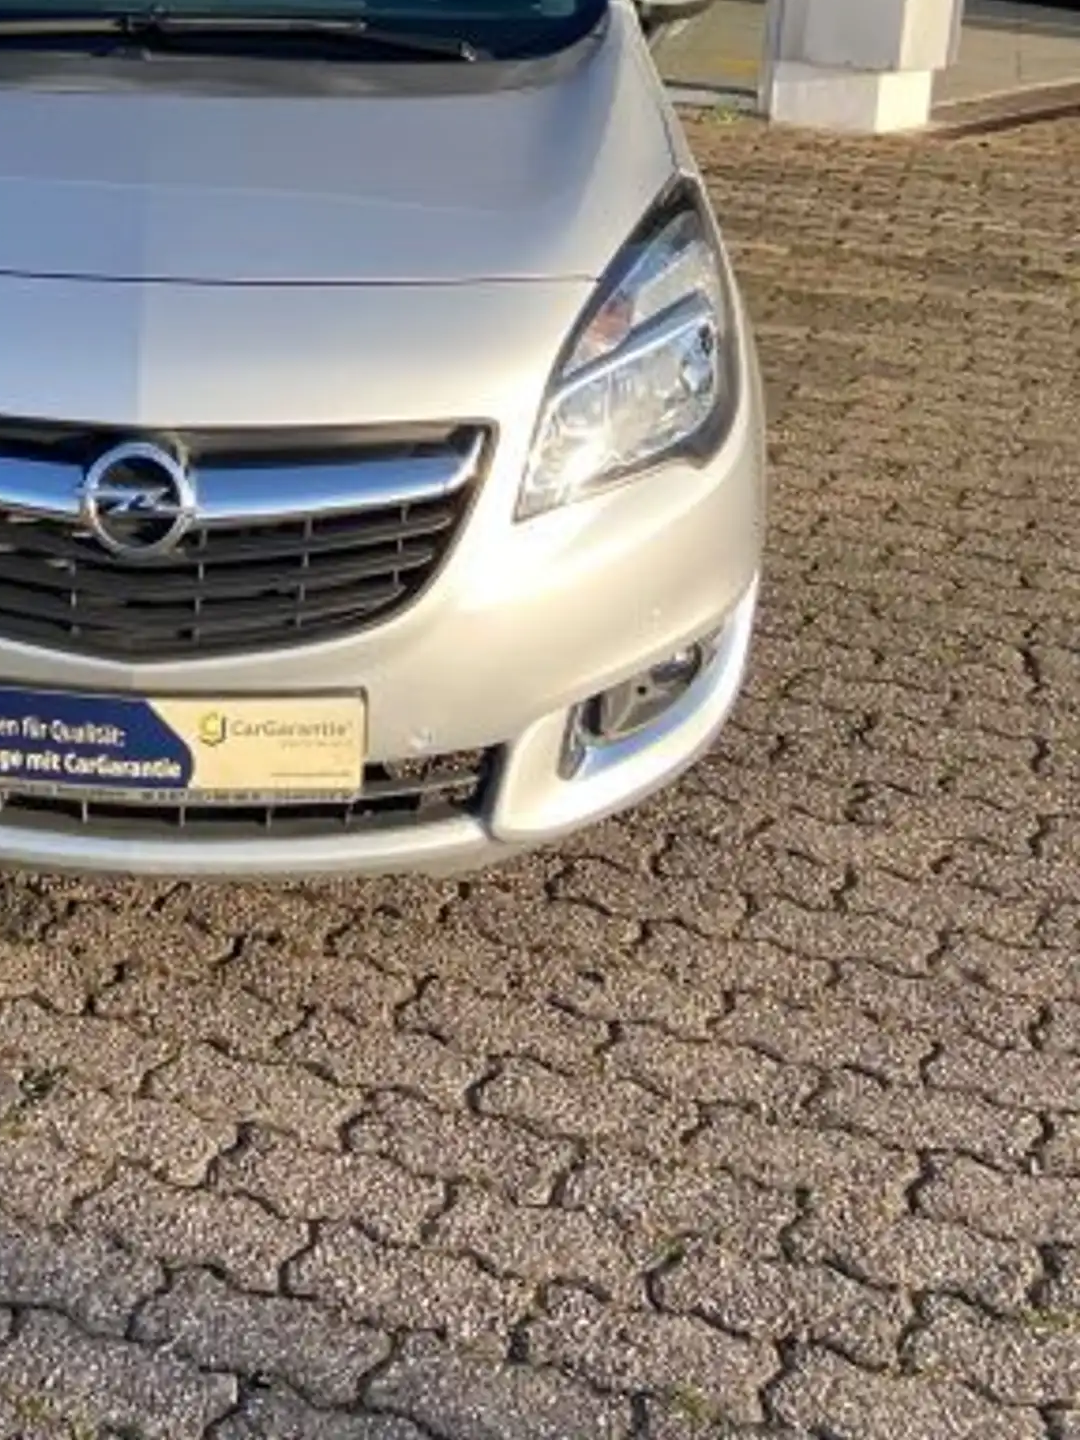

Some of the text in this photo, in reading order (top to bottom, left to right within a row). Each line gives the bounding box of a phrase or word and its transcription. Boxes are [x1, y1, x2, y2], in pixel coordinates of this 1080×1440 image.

[22, 715, 48, 740] für
[52, 720, 125, 747] Qualität:
[26, 750, 61, 772] mit
[64, 753, 182, 778] CarGarantie
